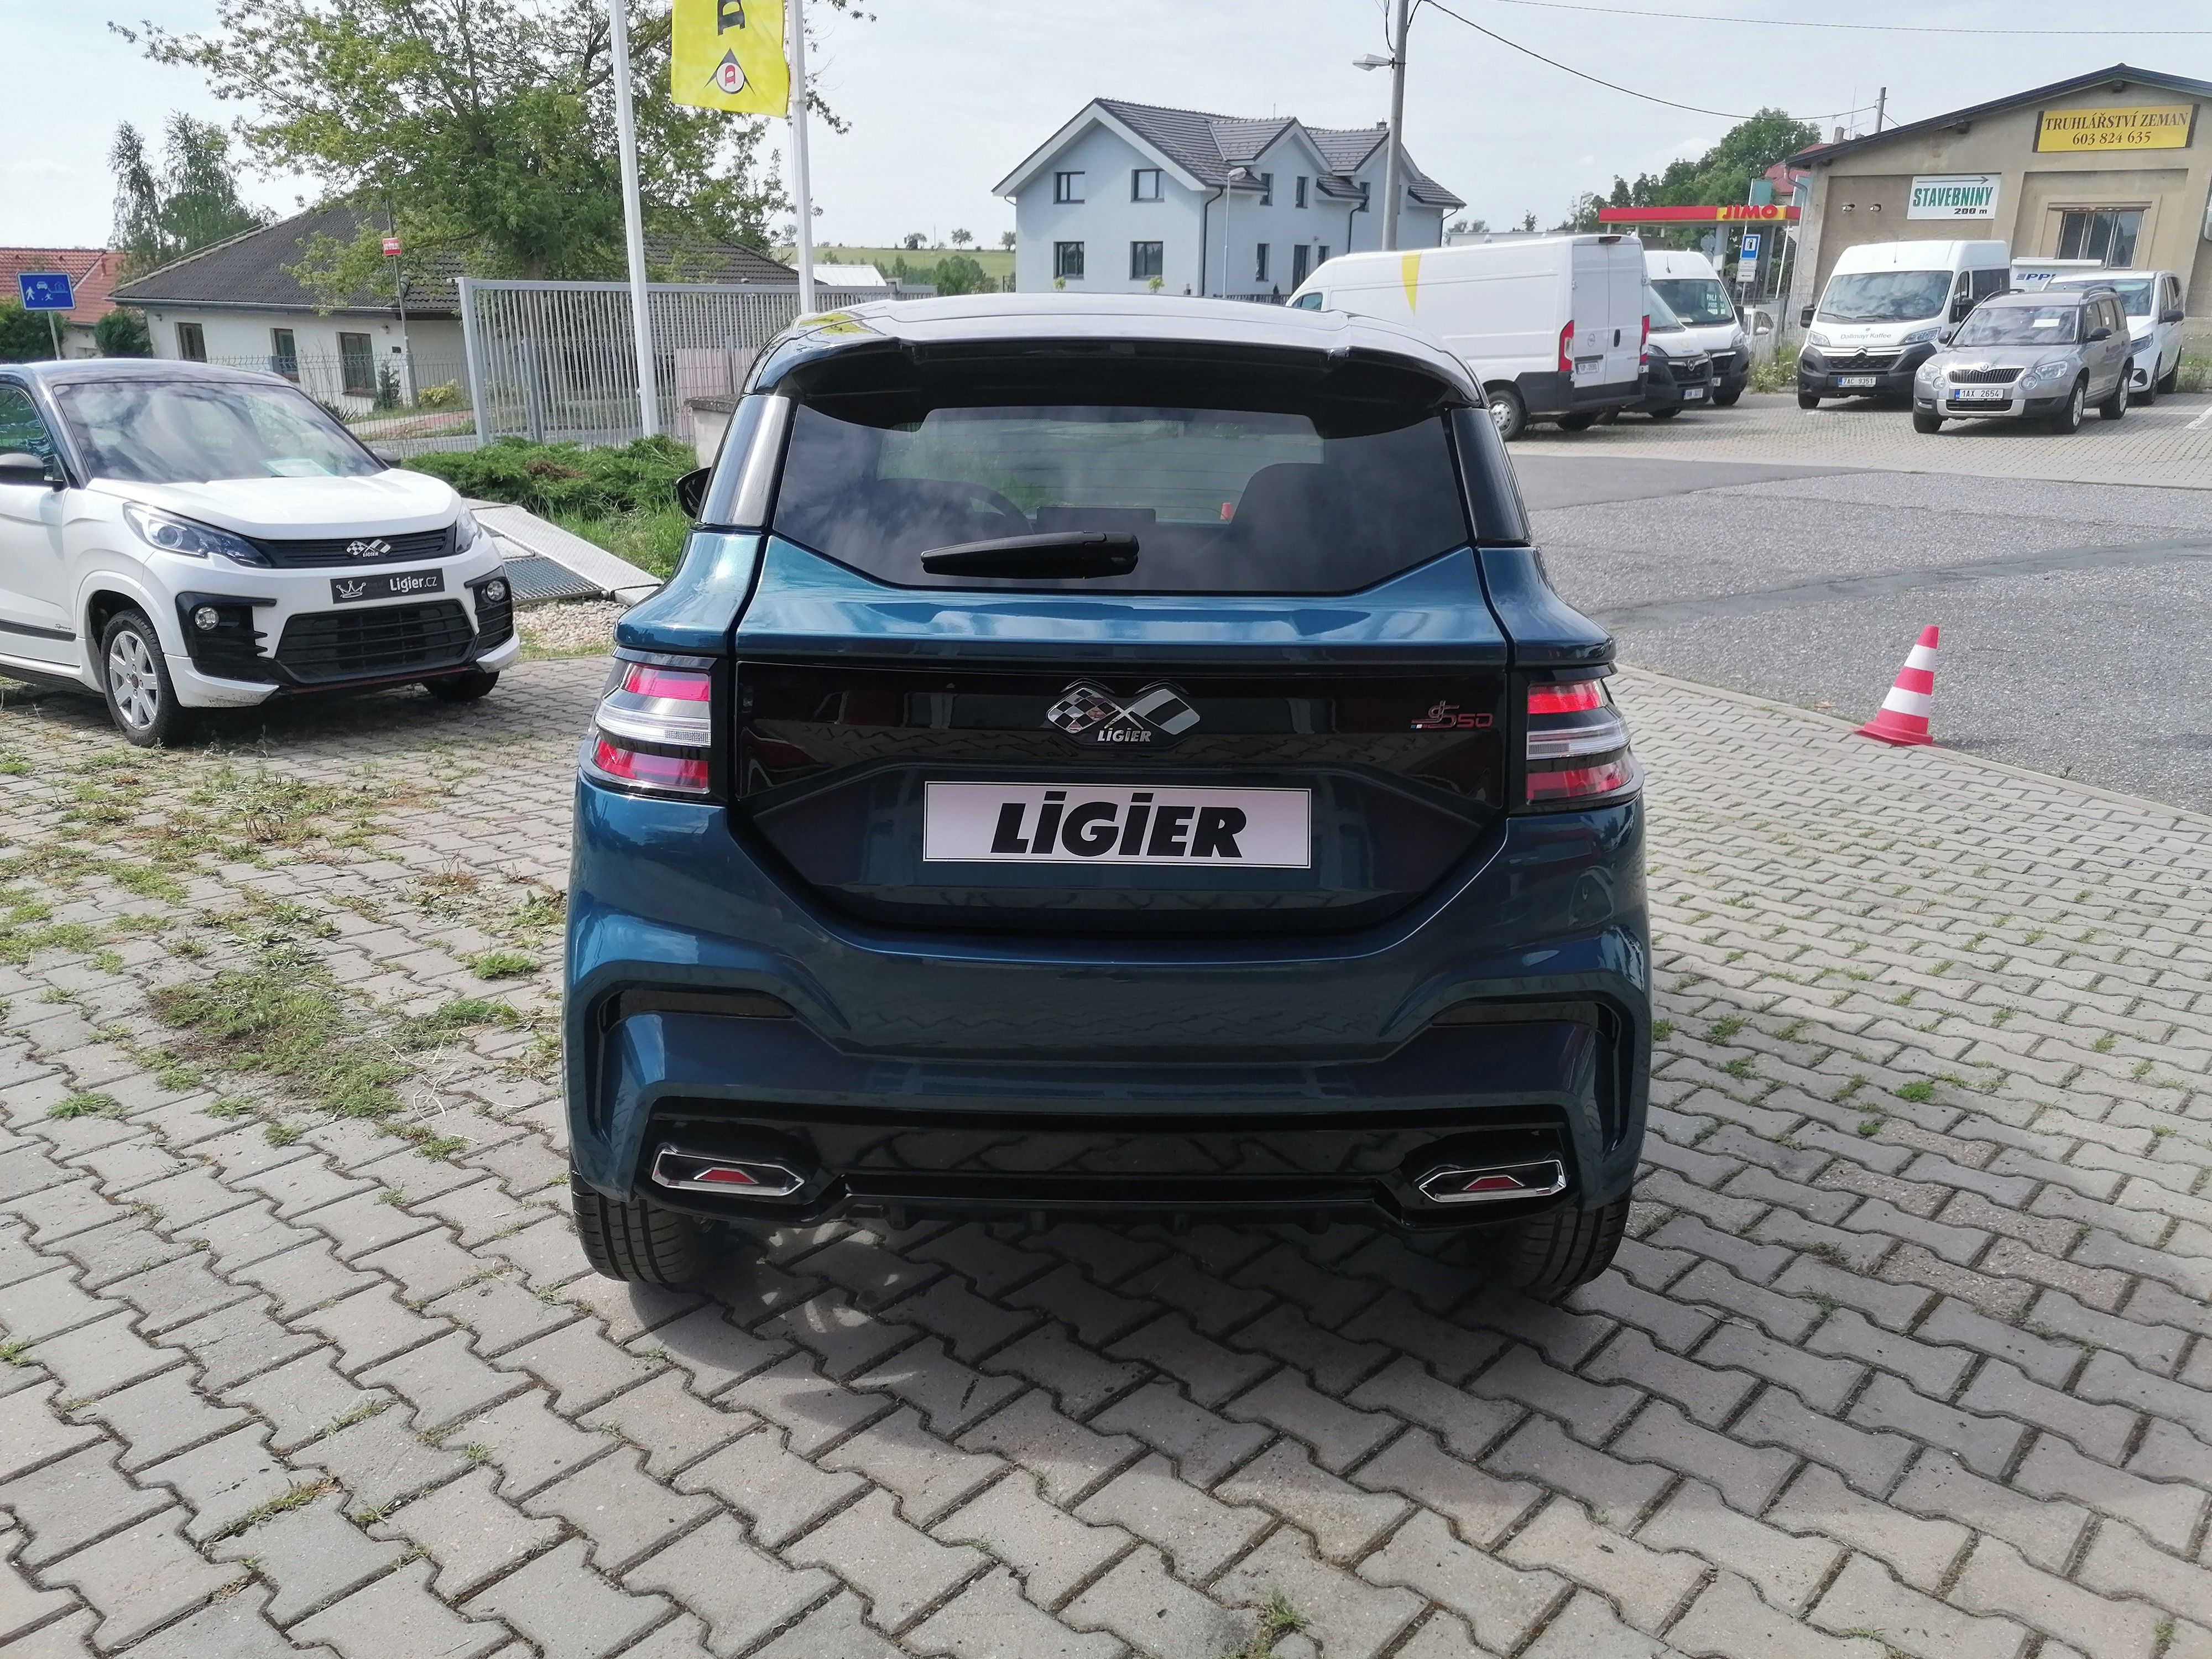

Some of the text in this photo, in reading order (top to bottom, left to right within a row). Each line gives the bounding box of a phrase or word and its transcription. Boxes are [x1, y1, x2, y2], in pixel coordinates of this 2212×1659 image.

[2046, 111, 2188, 130] TRUHLÁŘSTVÍ ZEMAN
[2072, 130, 2151, 145] 603 824 635
[1913, 187, 1994, 207] STAVEBNINY
[1722, 204, 1778, 219] JIMO
